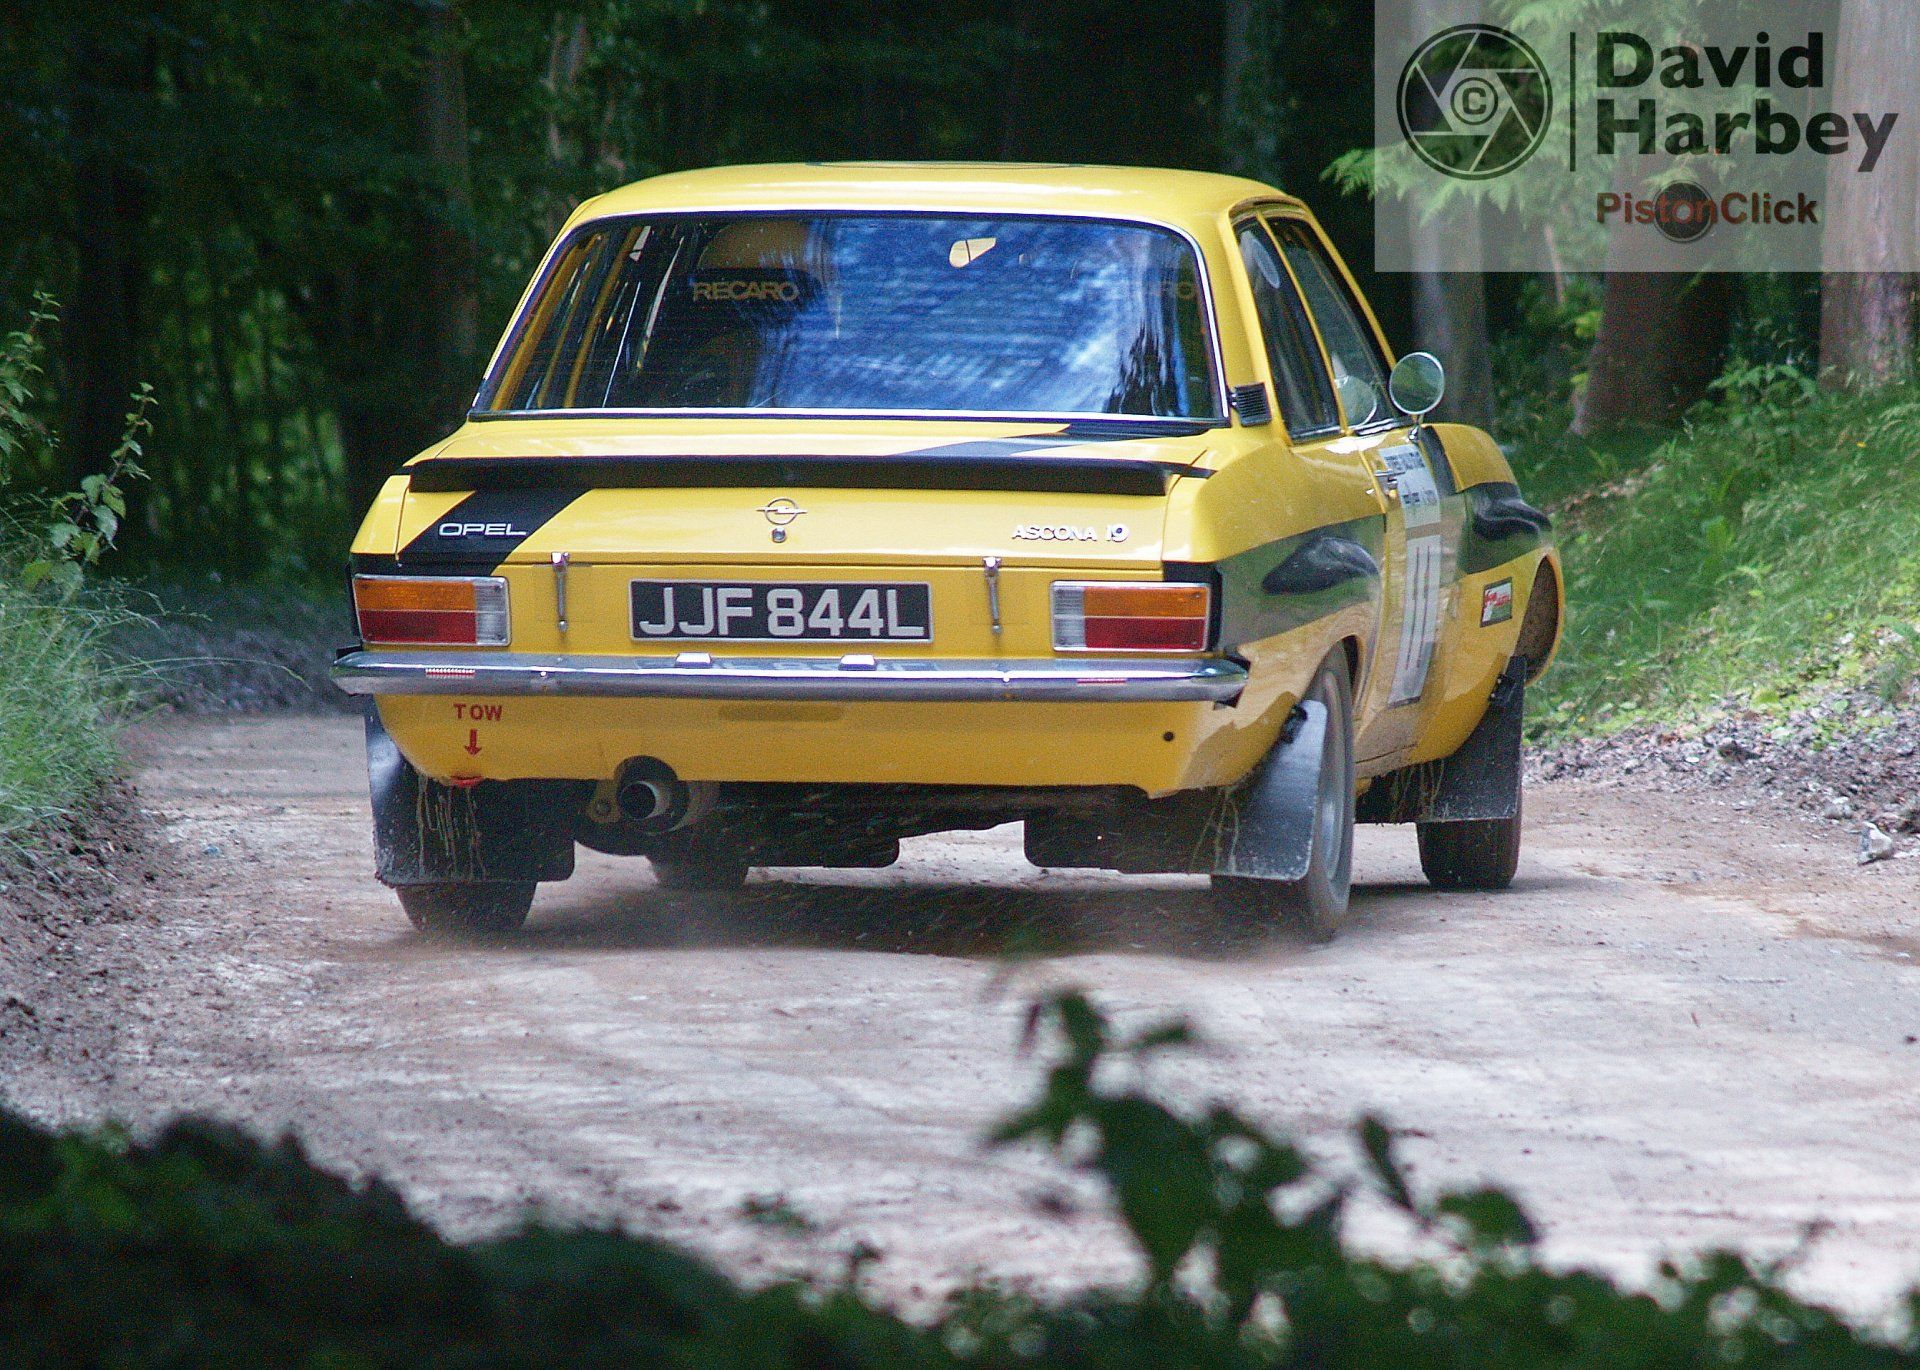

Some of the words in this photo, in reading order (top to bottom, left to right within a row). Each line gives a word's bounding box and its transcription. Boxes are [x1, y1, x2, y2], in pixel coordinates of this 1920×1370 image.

[693, 281, 800, 301] RECARO
[438, 522, 527, 537] OPEL
[1010, 525, 1098, 541] ASCONA
[638, 586, 753, 636] JJF
[766, 588, 925, 637] 844L
[453, 702, 503, 721] TOW
